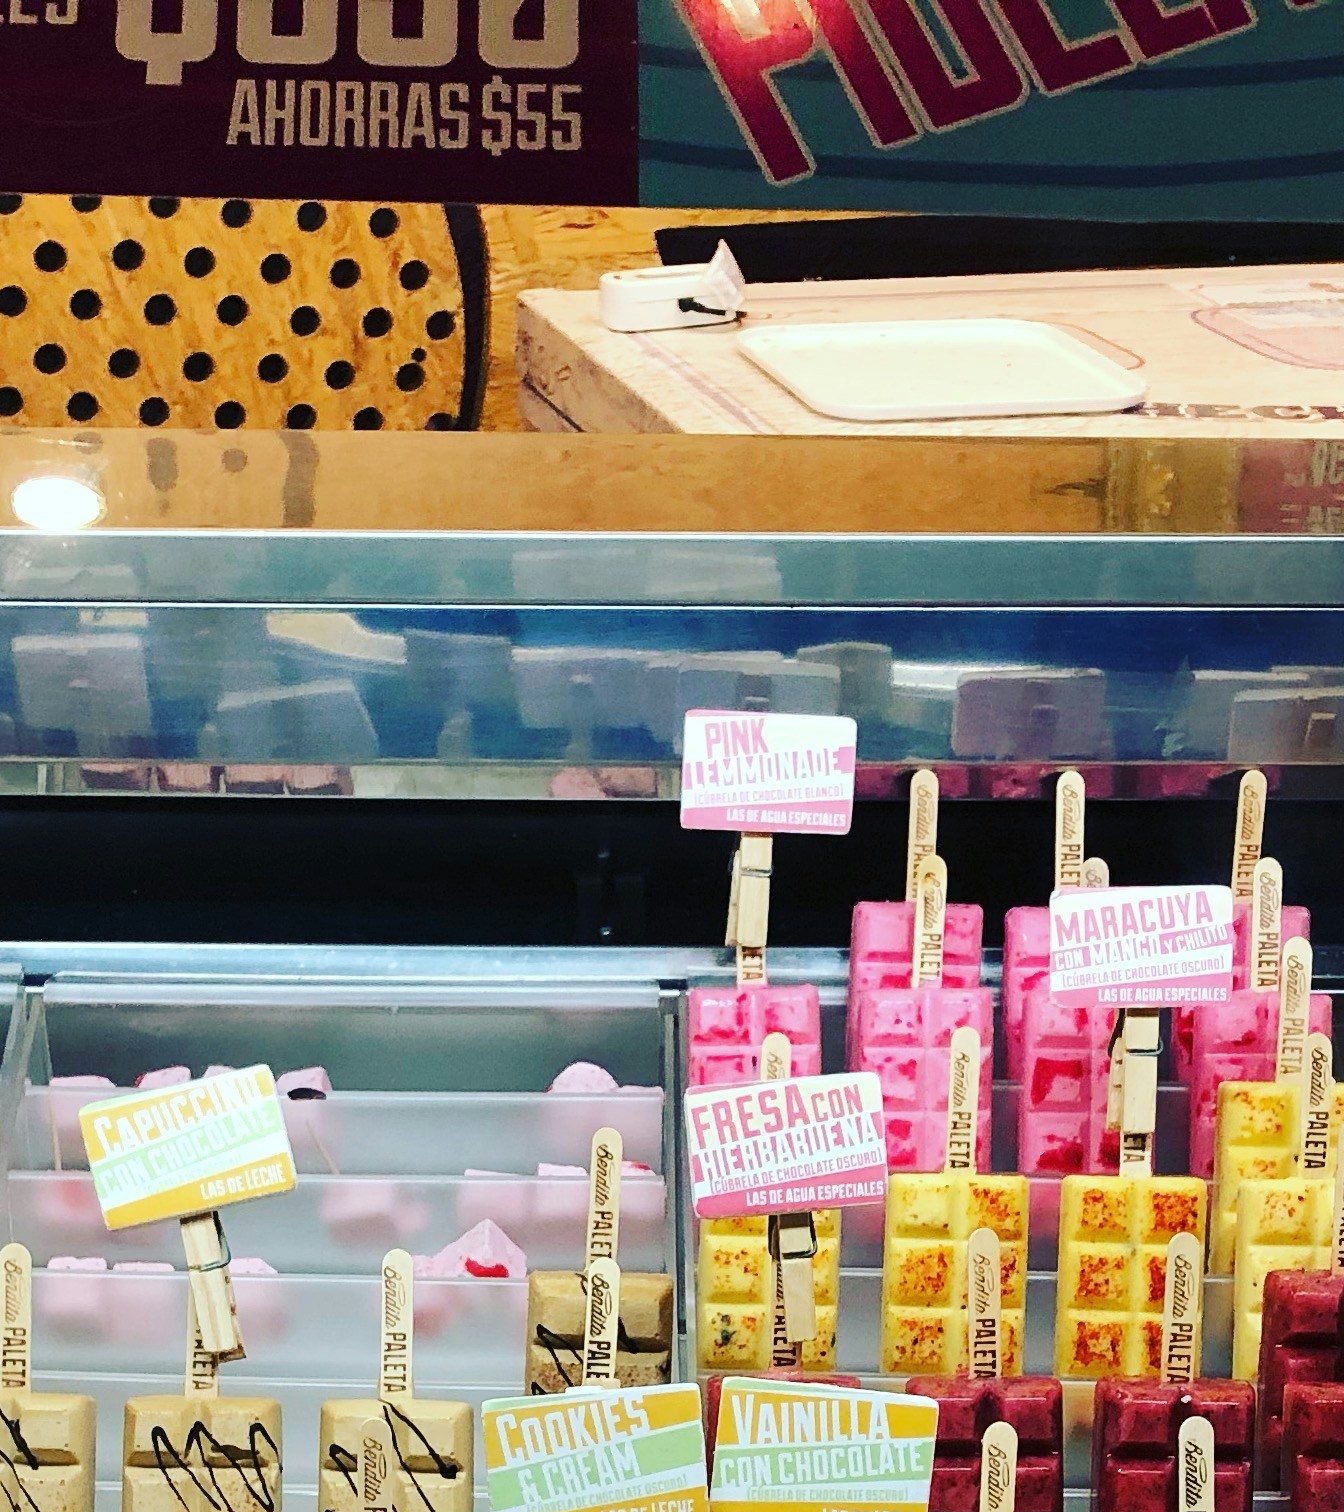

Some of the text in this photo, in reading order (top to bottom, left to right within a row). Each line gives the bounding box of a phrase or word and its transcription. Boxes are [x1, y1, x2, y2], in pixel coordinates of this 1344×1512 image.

[705, 718, 768, 759] PINK
[1055, 891, 1213, 947] MARACUYA
[1055, 948, 1084, 970] CON
[1164, 940, 1174, 954] Y
[1176, 925, 1228, 951] CHILITO
[1098, 988, 1227, 1001] LAS DE AGUA ESPECIALES
[691, 1084, 863, 1150] FRESA CON
[949, 1112, 976, 1168] PALETA
[99, 1156, 149, 1199] CON
[148, 1106, 275, 1177] CHOCOLATE
[699, 1113, 878, 1182] HIERBABUENA
[746, 1181, 884, 1206] LAS DE AGUA ESPECIALES
[2, 1327, 26, 1388] PALETA
[495, 1396, 650, 1466] COOKIES
[731, 1394, 891, 1448] VAINILLA
[517, 1439, 641, 1505] & CREAM
[720, 1440, 924, 1488] CON CHOCOLATE
